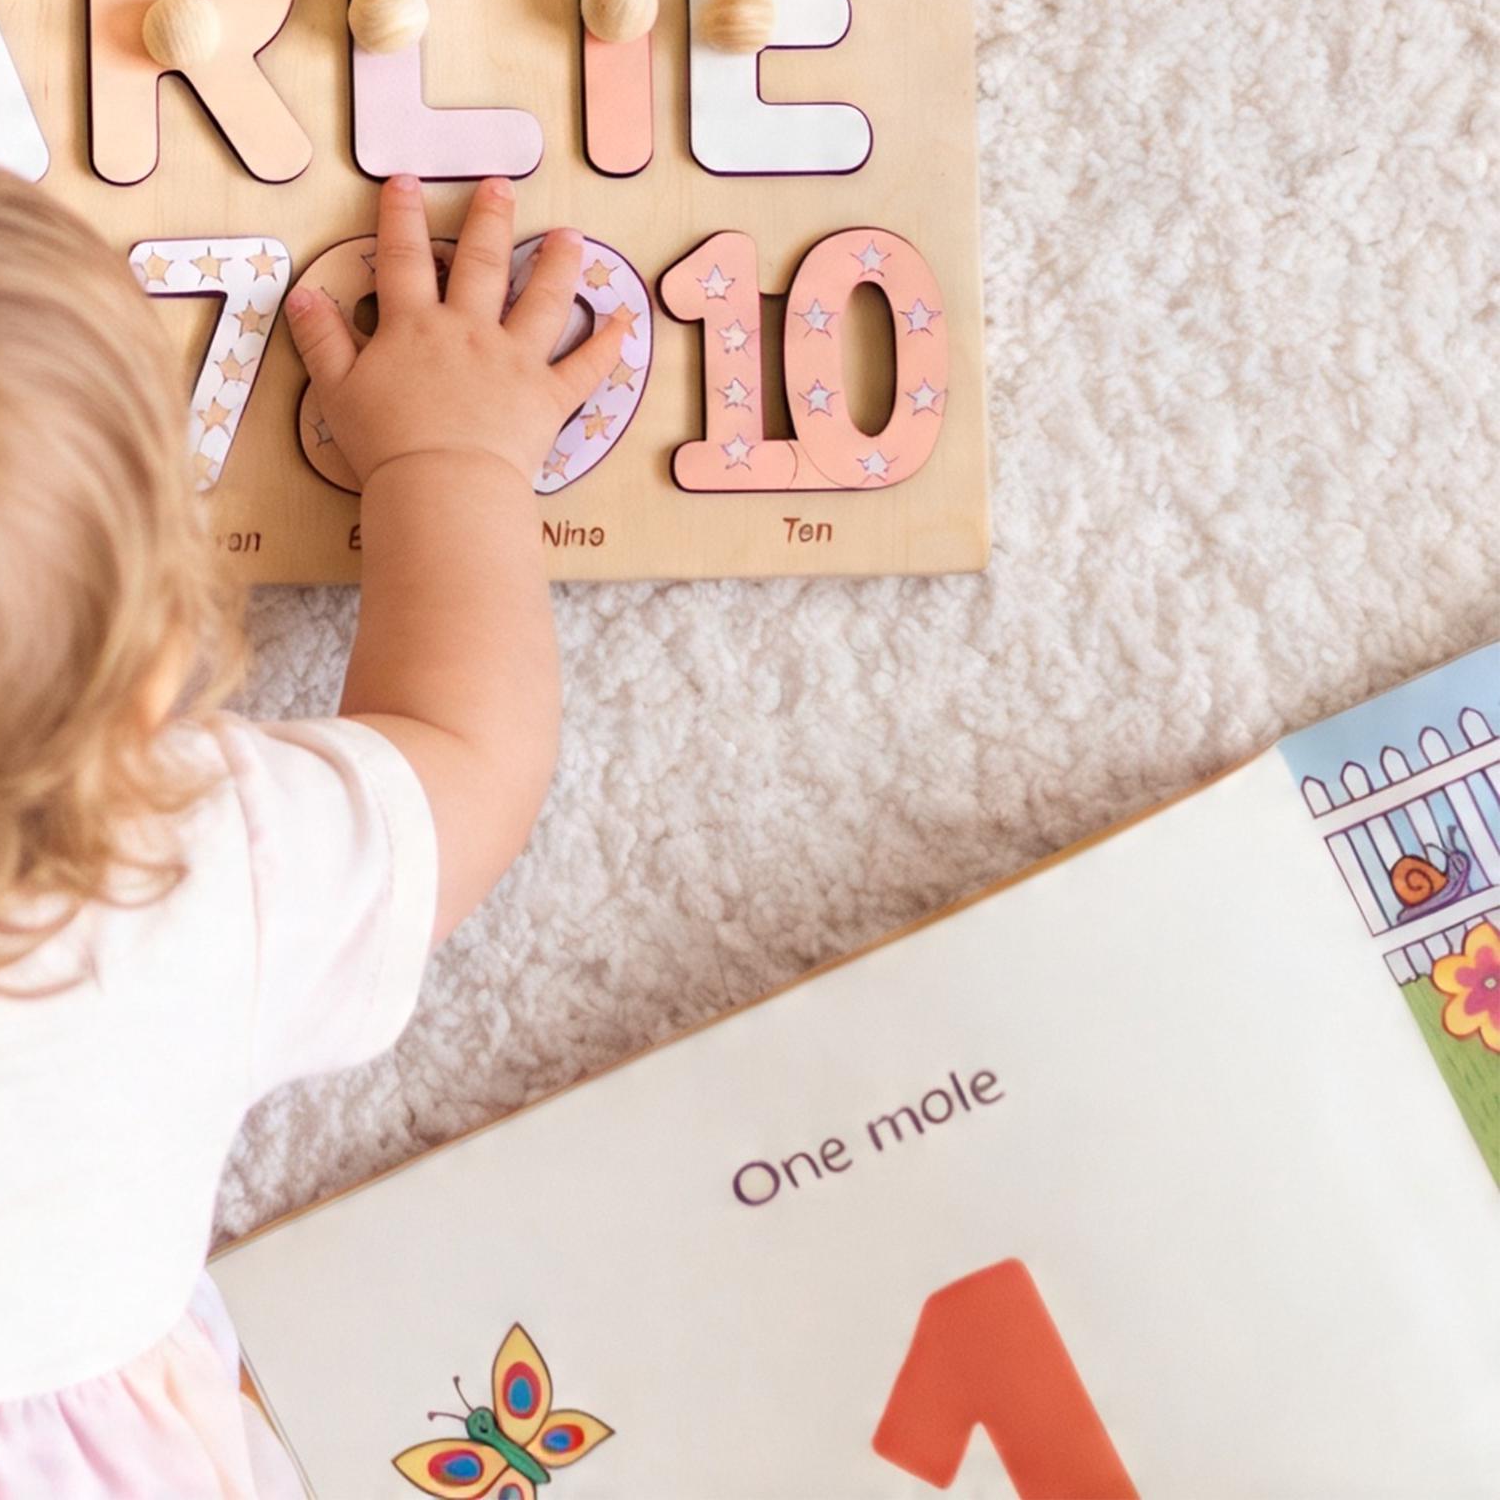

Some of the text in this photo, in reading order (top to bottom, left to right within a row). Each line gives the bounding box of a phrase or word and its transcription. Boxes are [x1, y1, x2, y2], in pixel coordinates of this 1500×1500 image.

[128, 236, 292, 493] 7
[655, 226, 950, 493] 10
[542, 520, 605, 547] Nine
[782, 517, 833, 544] Ten
[732, 1069, 1005, 1206] One mole
